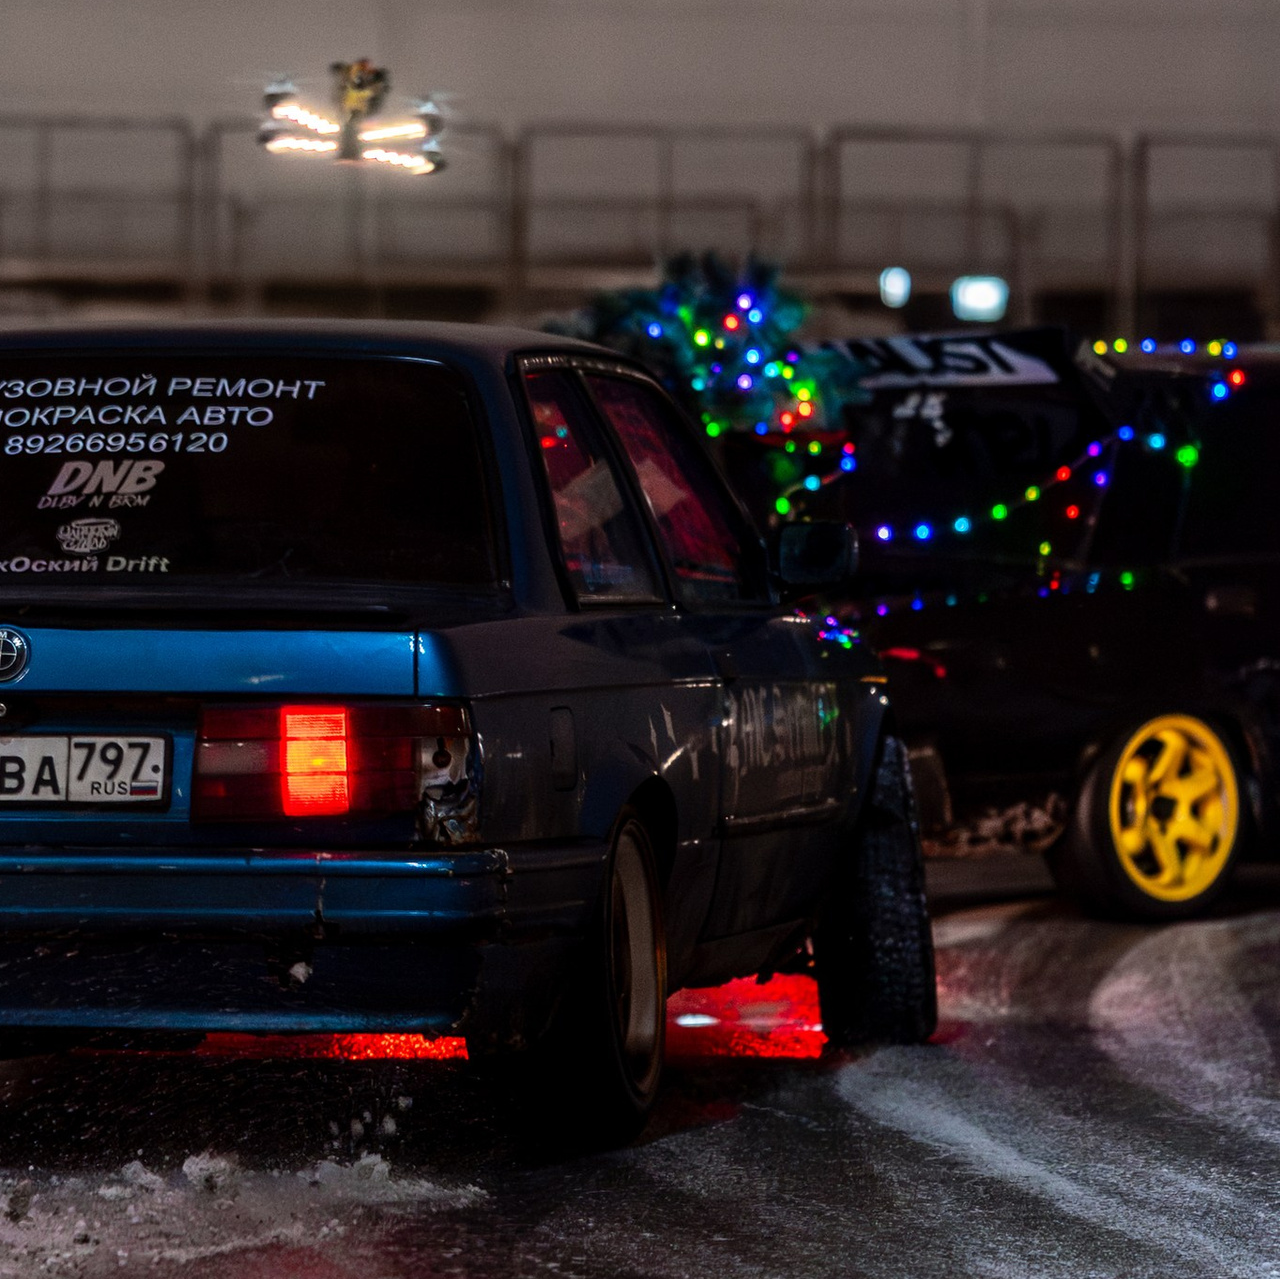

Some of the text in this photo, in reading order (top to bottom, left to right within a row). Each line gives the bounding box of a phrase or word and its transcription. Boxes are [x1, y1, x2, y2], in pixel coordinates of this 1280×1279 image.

[167, 377, 326, 400] РЕМОНТ
[176, 406, 274, 427] АВТО
[4, 432, 228, 455] 89266956120
[46, 459, 166, 496] DNB
[105, 555, 171, 572] Drift
[73, 741, 152, 782] 797
[90, 780, 128, 796] RUS
